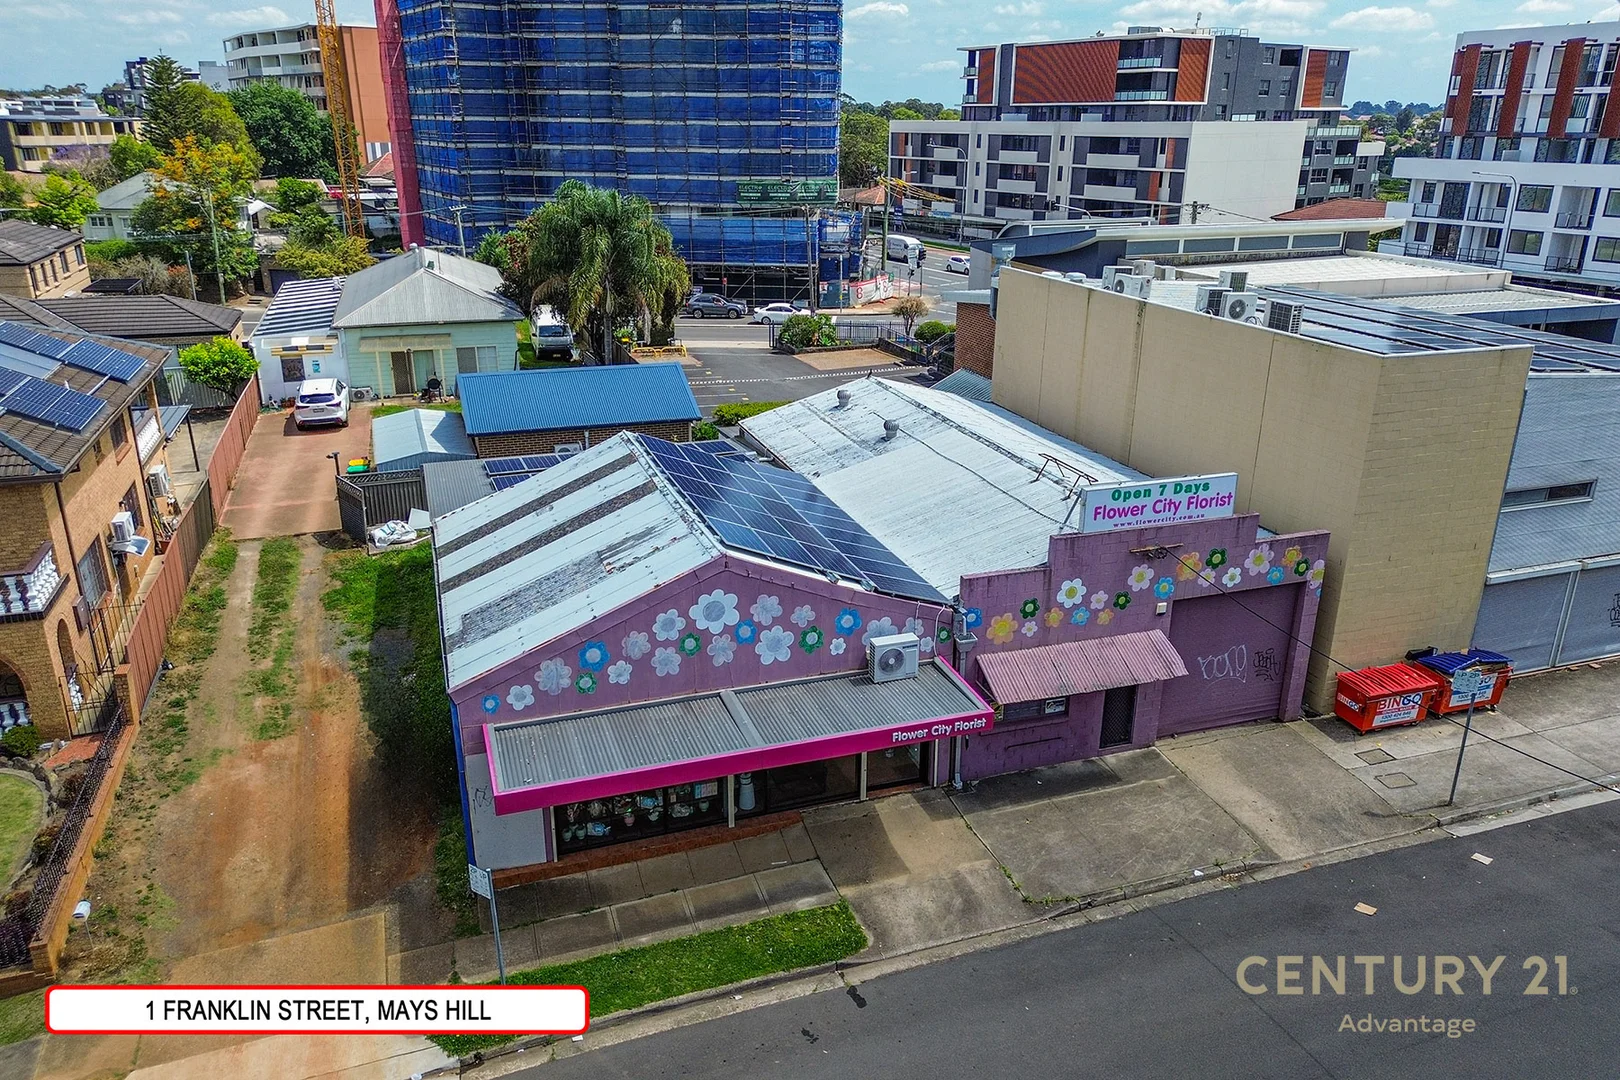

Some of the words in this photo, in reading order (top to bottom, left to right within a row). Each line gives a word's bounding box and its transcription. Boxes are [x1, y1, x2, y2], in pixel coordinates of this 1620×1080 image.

[1111, 488, 1151, 502] Open
[1159, 484, 1167, 496] 7
[1173, 481, 1210, 496] Days
[1093, 504, 1147, 521] Flower
[1152, 498, 1182, 516] City
[1186, 492, 1233, 511] Florist
[1113, 514, 1205, 528] www.flowercity.com.au
[1377, 692, 1422, 711] BINGO
[892, 729, 928, 742] Flower
[931, 724, 952, 735] City
[954, 718, 986, 732] Florist
